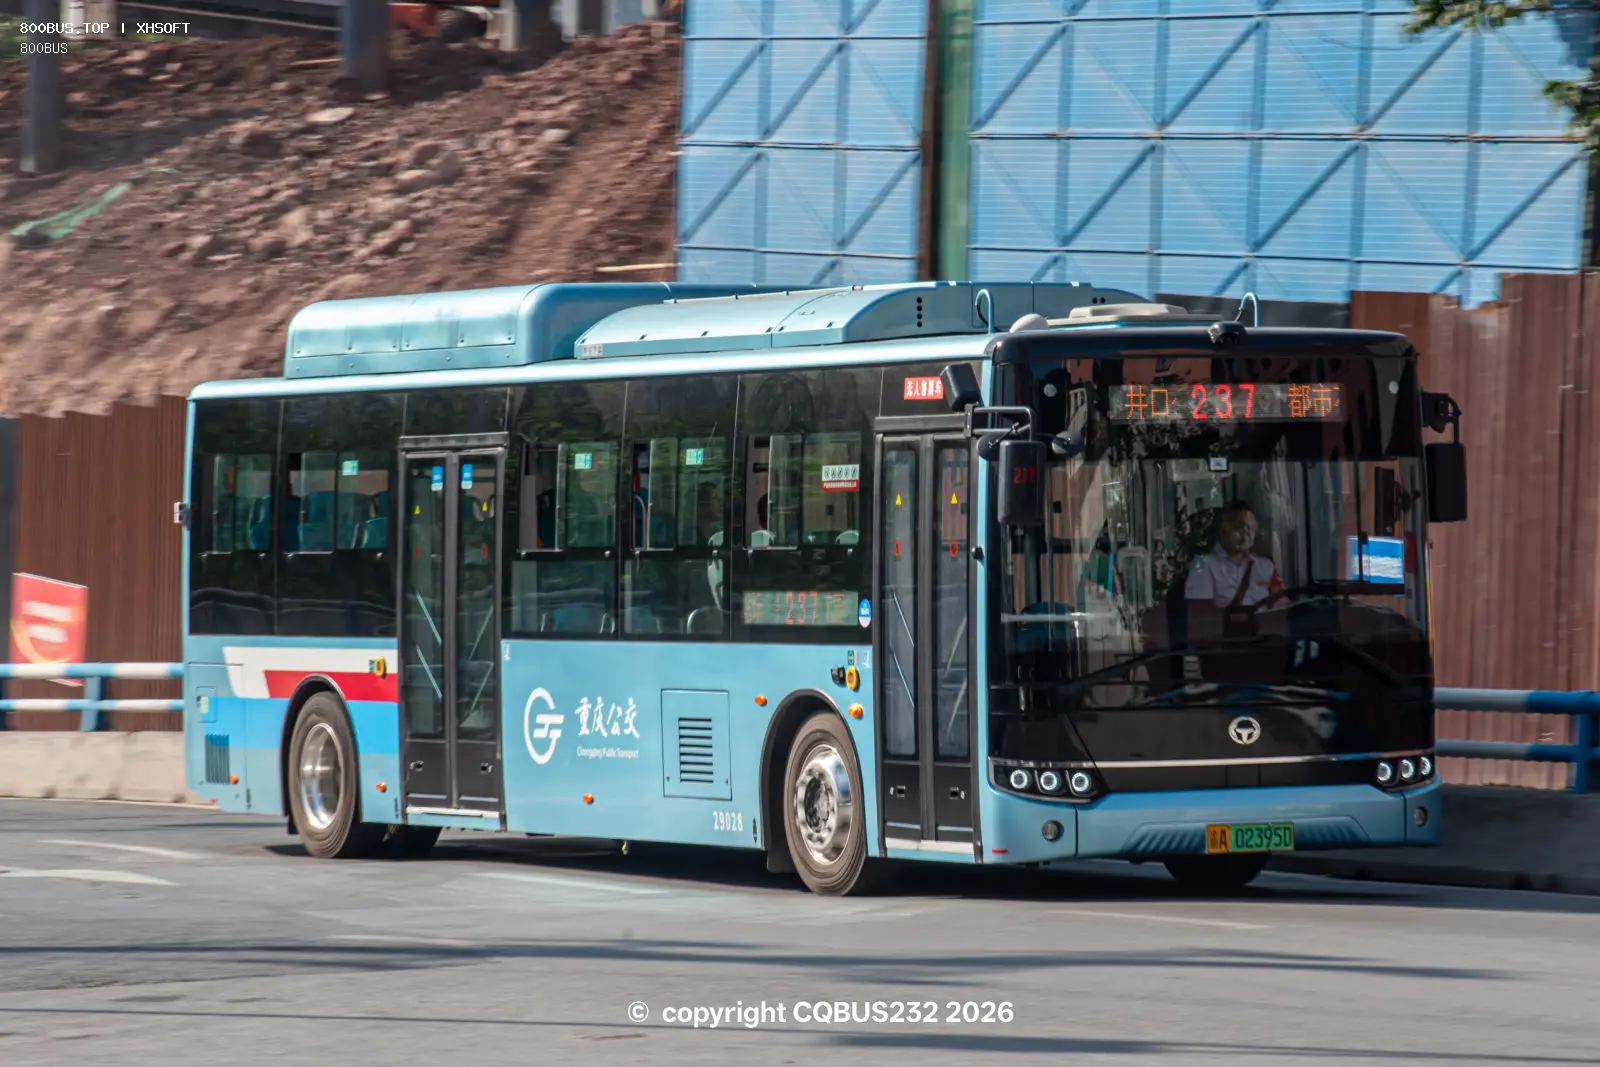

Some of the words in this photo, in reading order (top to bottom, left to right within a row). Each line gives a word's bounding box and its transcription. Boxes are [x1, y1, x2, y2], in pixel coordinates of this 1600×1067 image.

[1124, 383, 1177, 420] 井口
[1191, 384, 1255, 420] 237
[785, 591, 818, 626] 237
[574, 696, 640, 738] 重庆公交
[603, 746, 616, 758] Public
[617, 748, 639, 760] Transport
[712, 810, 743, 832] 29028
